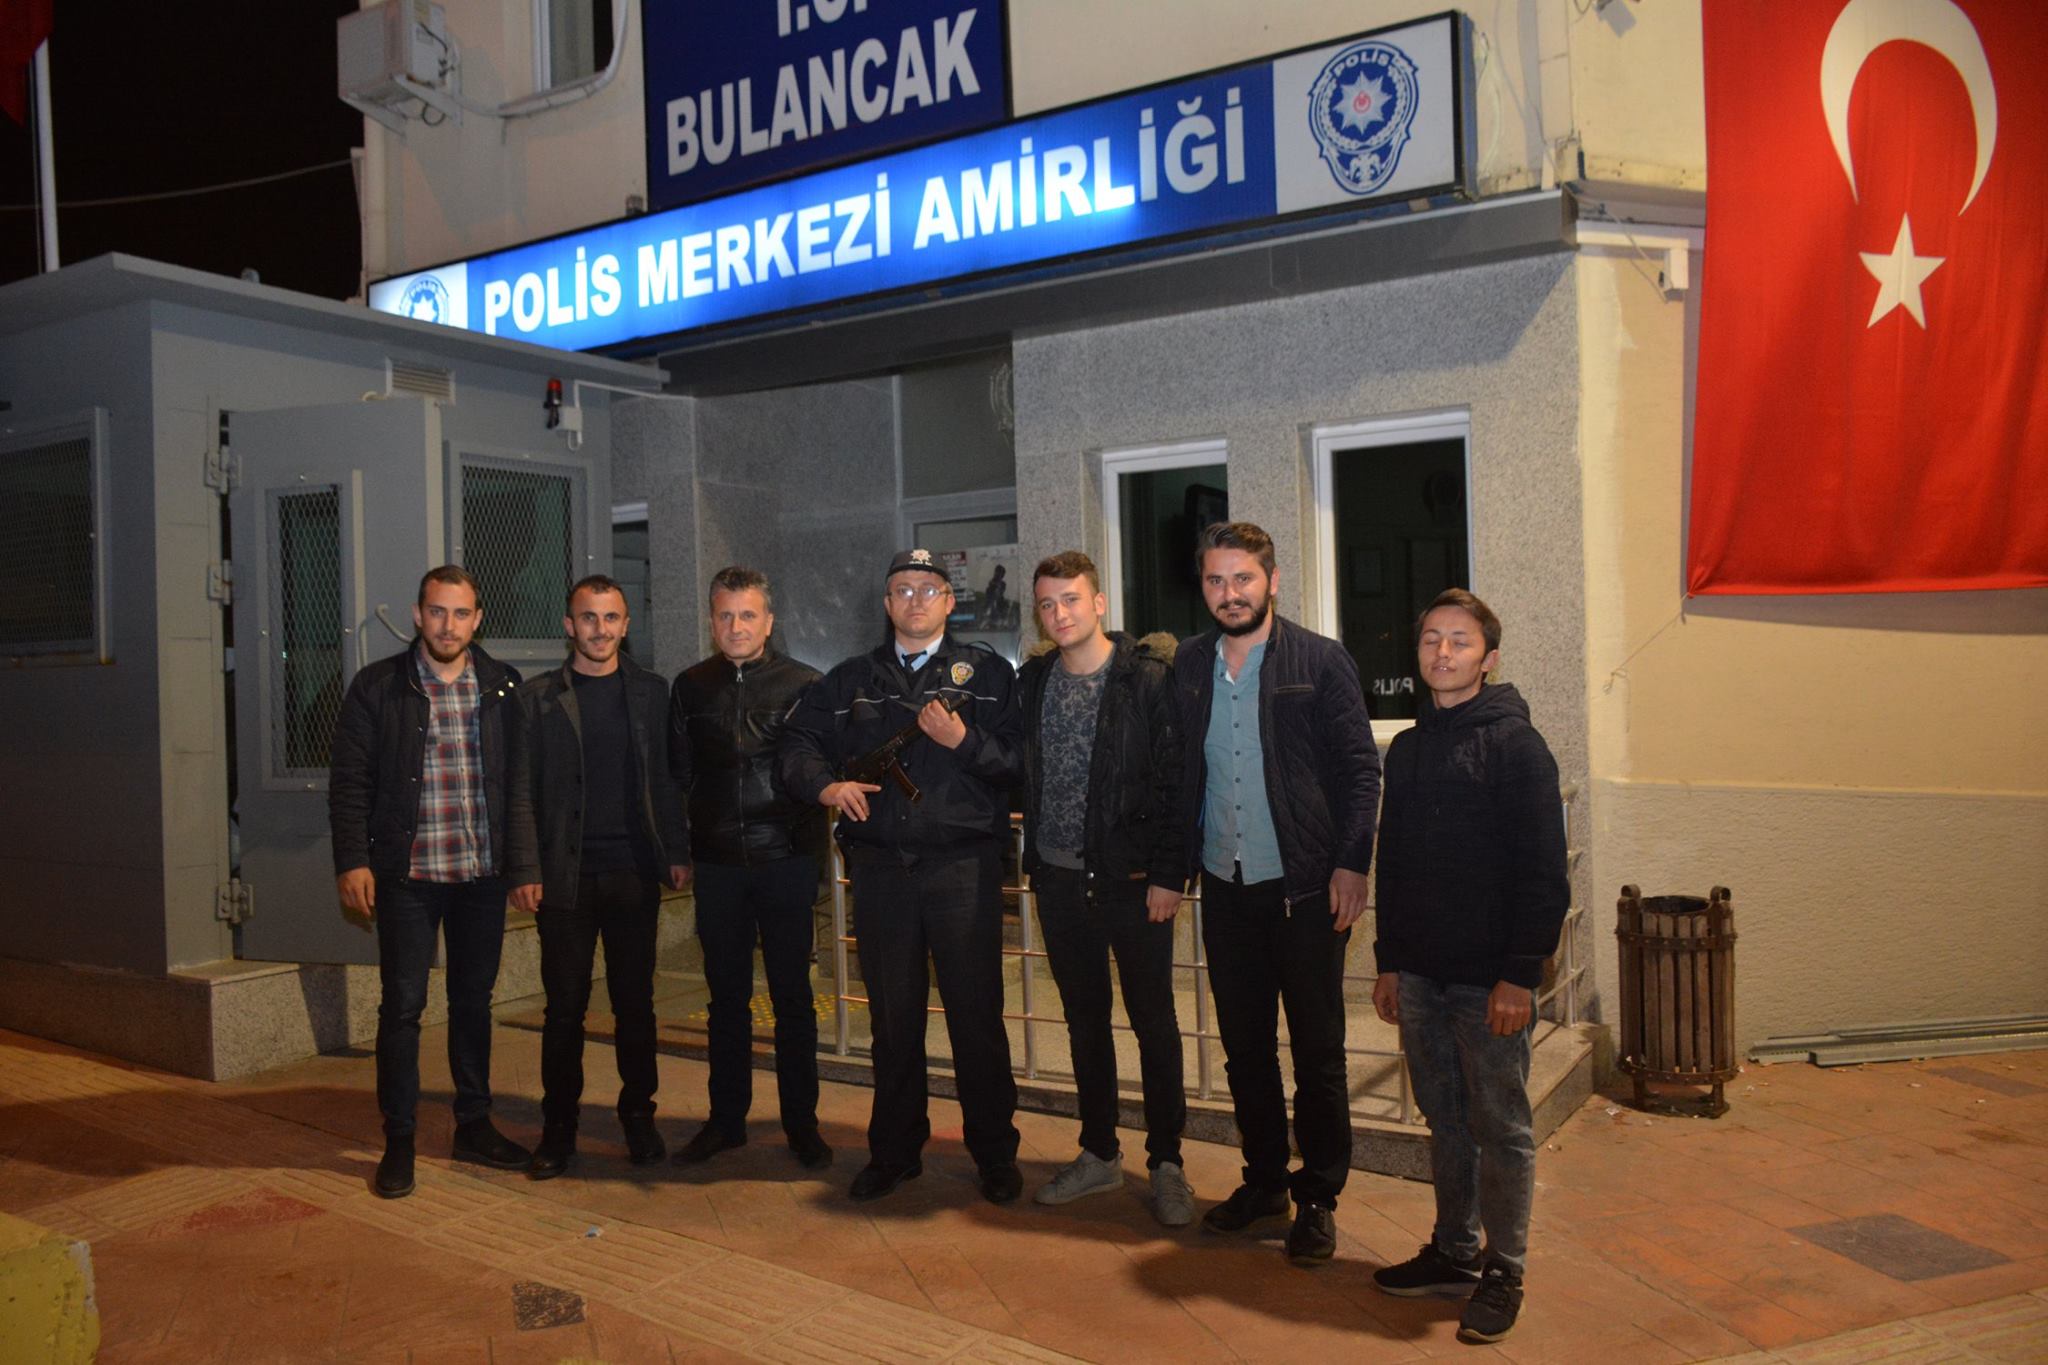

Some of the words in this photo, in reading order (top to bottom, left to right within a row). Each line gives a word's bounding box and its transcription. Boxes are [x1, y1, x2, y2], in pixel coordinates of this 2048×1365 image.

[666, 8, 981, 176] BULANCAK
[484, 246, 622, 335] POLİS
[637, 172, 891, 307] MERKEZİ
[913, 86, 1245, 250] AMİRLİĞİ
